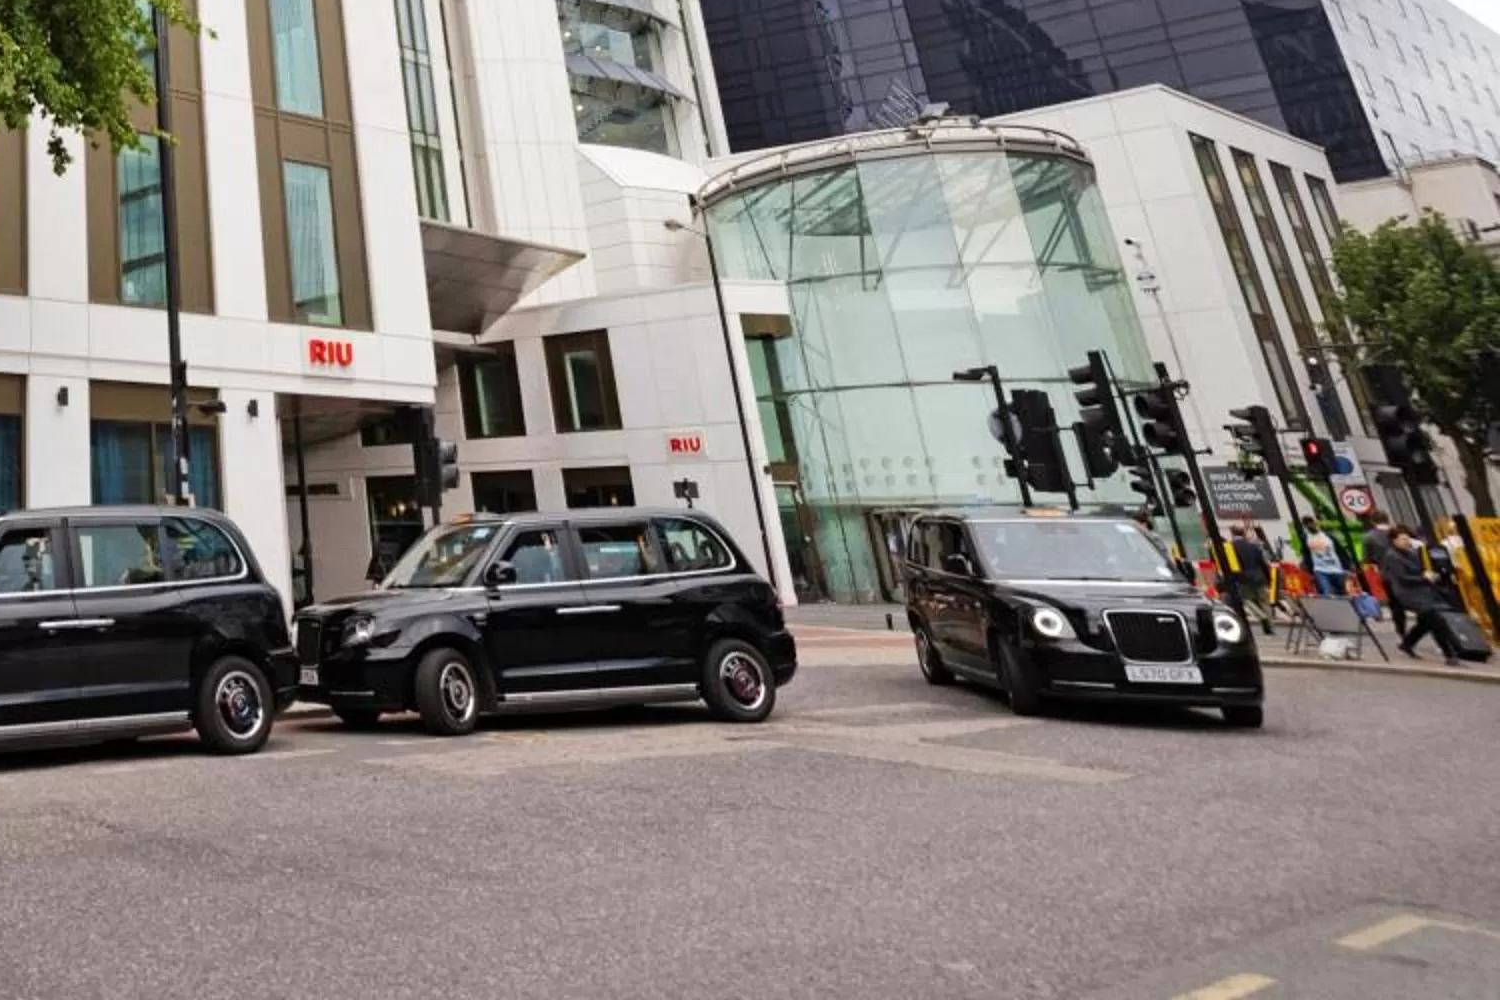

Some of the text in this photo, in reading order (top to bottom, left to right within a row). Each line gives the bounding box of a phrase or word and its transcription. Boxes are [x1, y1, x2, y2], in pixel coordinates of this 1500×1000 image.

[309, 338, 353, 367] RIU
[669, 437, 701, 453] RIU
[1212, 483, 1256, 491] LONDON
[1216, 492, 1265, 501] VICTORIA
